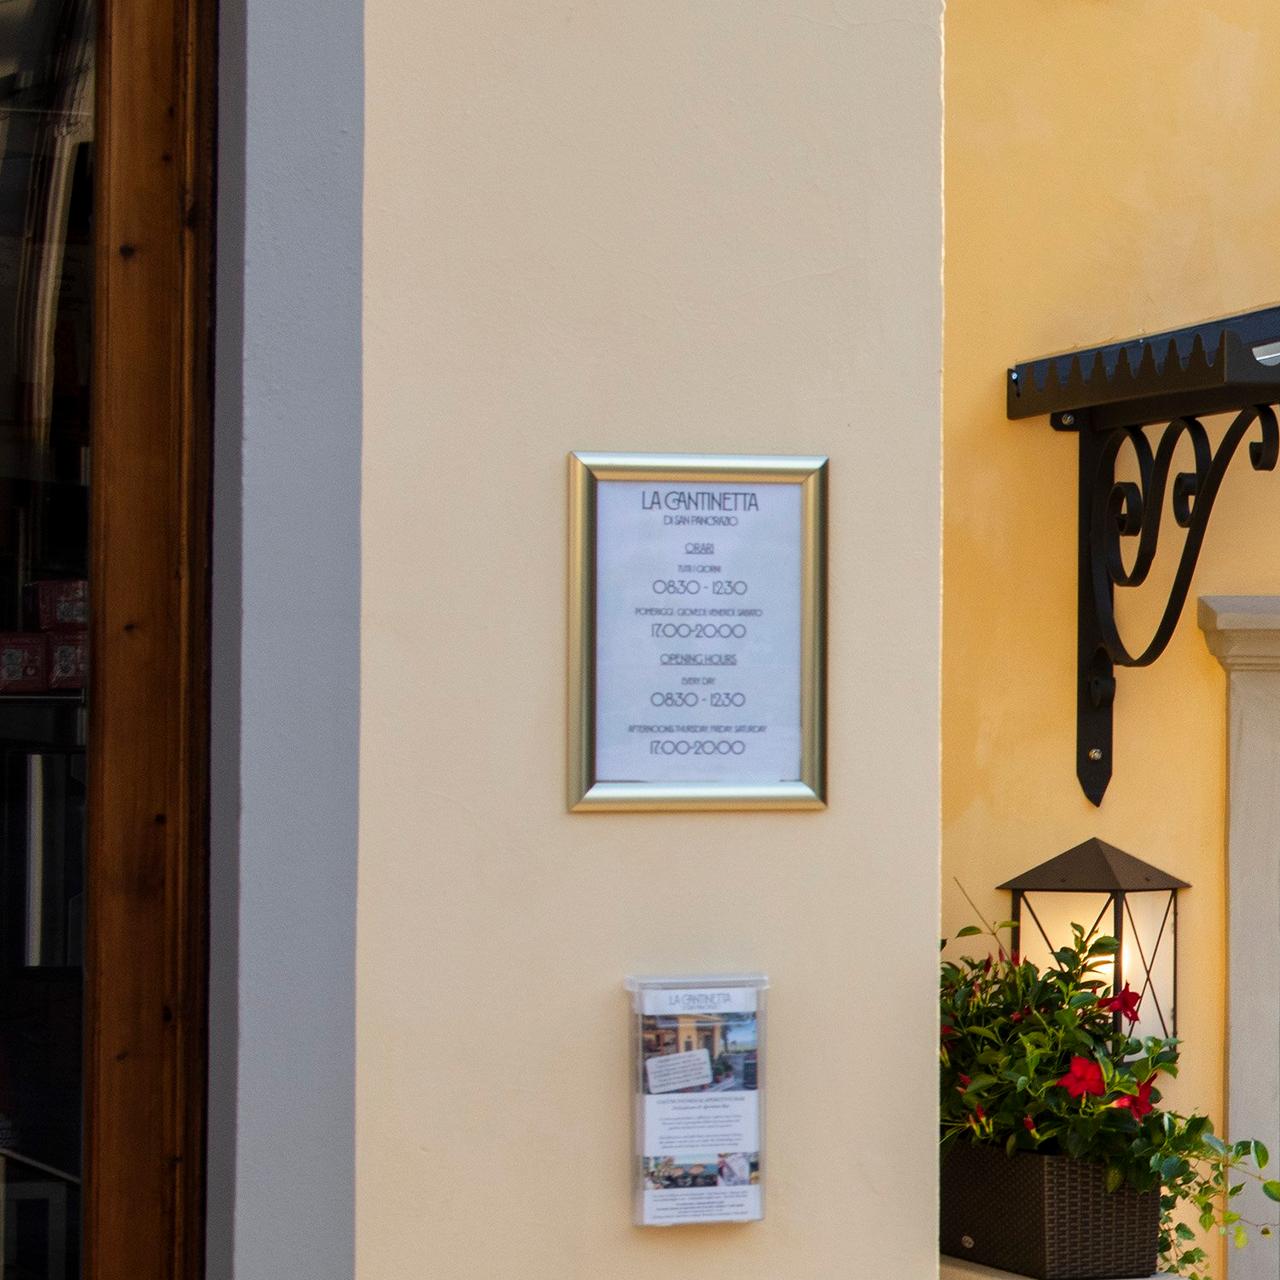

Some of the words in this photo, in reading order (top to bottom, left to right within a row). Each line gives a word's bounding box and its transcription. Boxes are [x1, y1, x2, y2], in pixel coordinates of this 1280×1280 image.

[641, 491, 662, 510] LA
[660, 653, 703, 665] OPENING
[704, 653, 738, 665] HOURS
